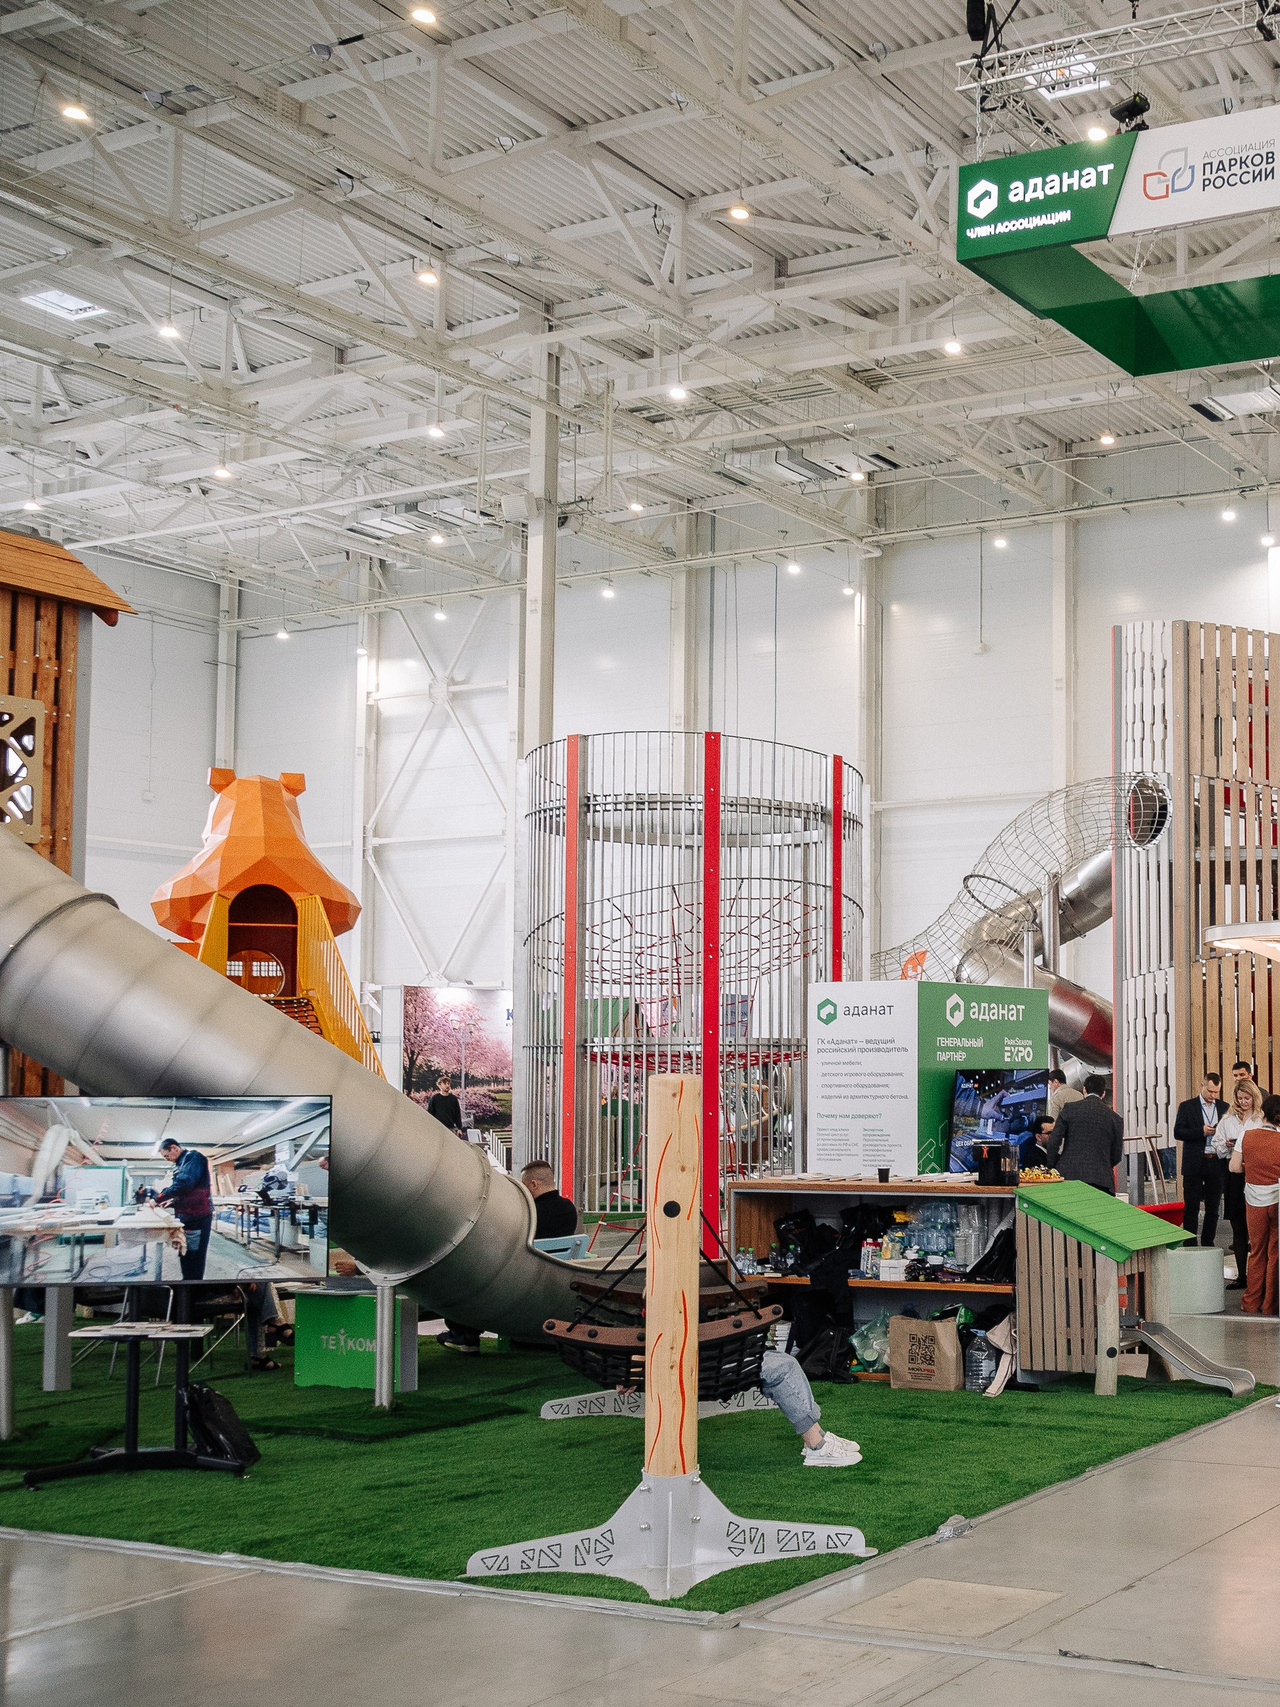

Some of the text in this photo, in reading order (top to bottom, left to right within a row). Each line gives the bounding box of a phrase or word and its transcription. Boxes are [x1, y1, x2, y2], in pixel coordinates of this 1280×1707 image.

[1203, 139, 1276, 160] АССОЦИАЦИЯ
[1203, 151, 1275, 176] ПАРКОВ
[1008, 163, 1115, 203] аданат
[1203, 166, 1275, 192] РОССИИ
[966, 210, 1072, 239] ЧЛЕН АССОЦИАЦИИ
[843, 1003, 894, 1019] аданат
[969, 1001, 1025, 1022] аданат
[937, 1037, 984, 1047] ГЕНЕРАЛЬНЫЙ
[937, 1050, 966, 1061] ПАРТНЁР
[1004, 1047, 1033, 1062] EXPO
